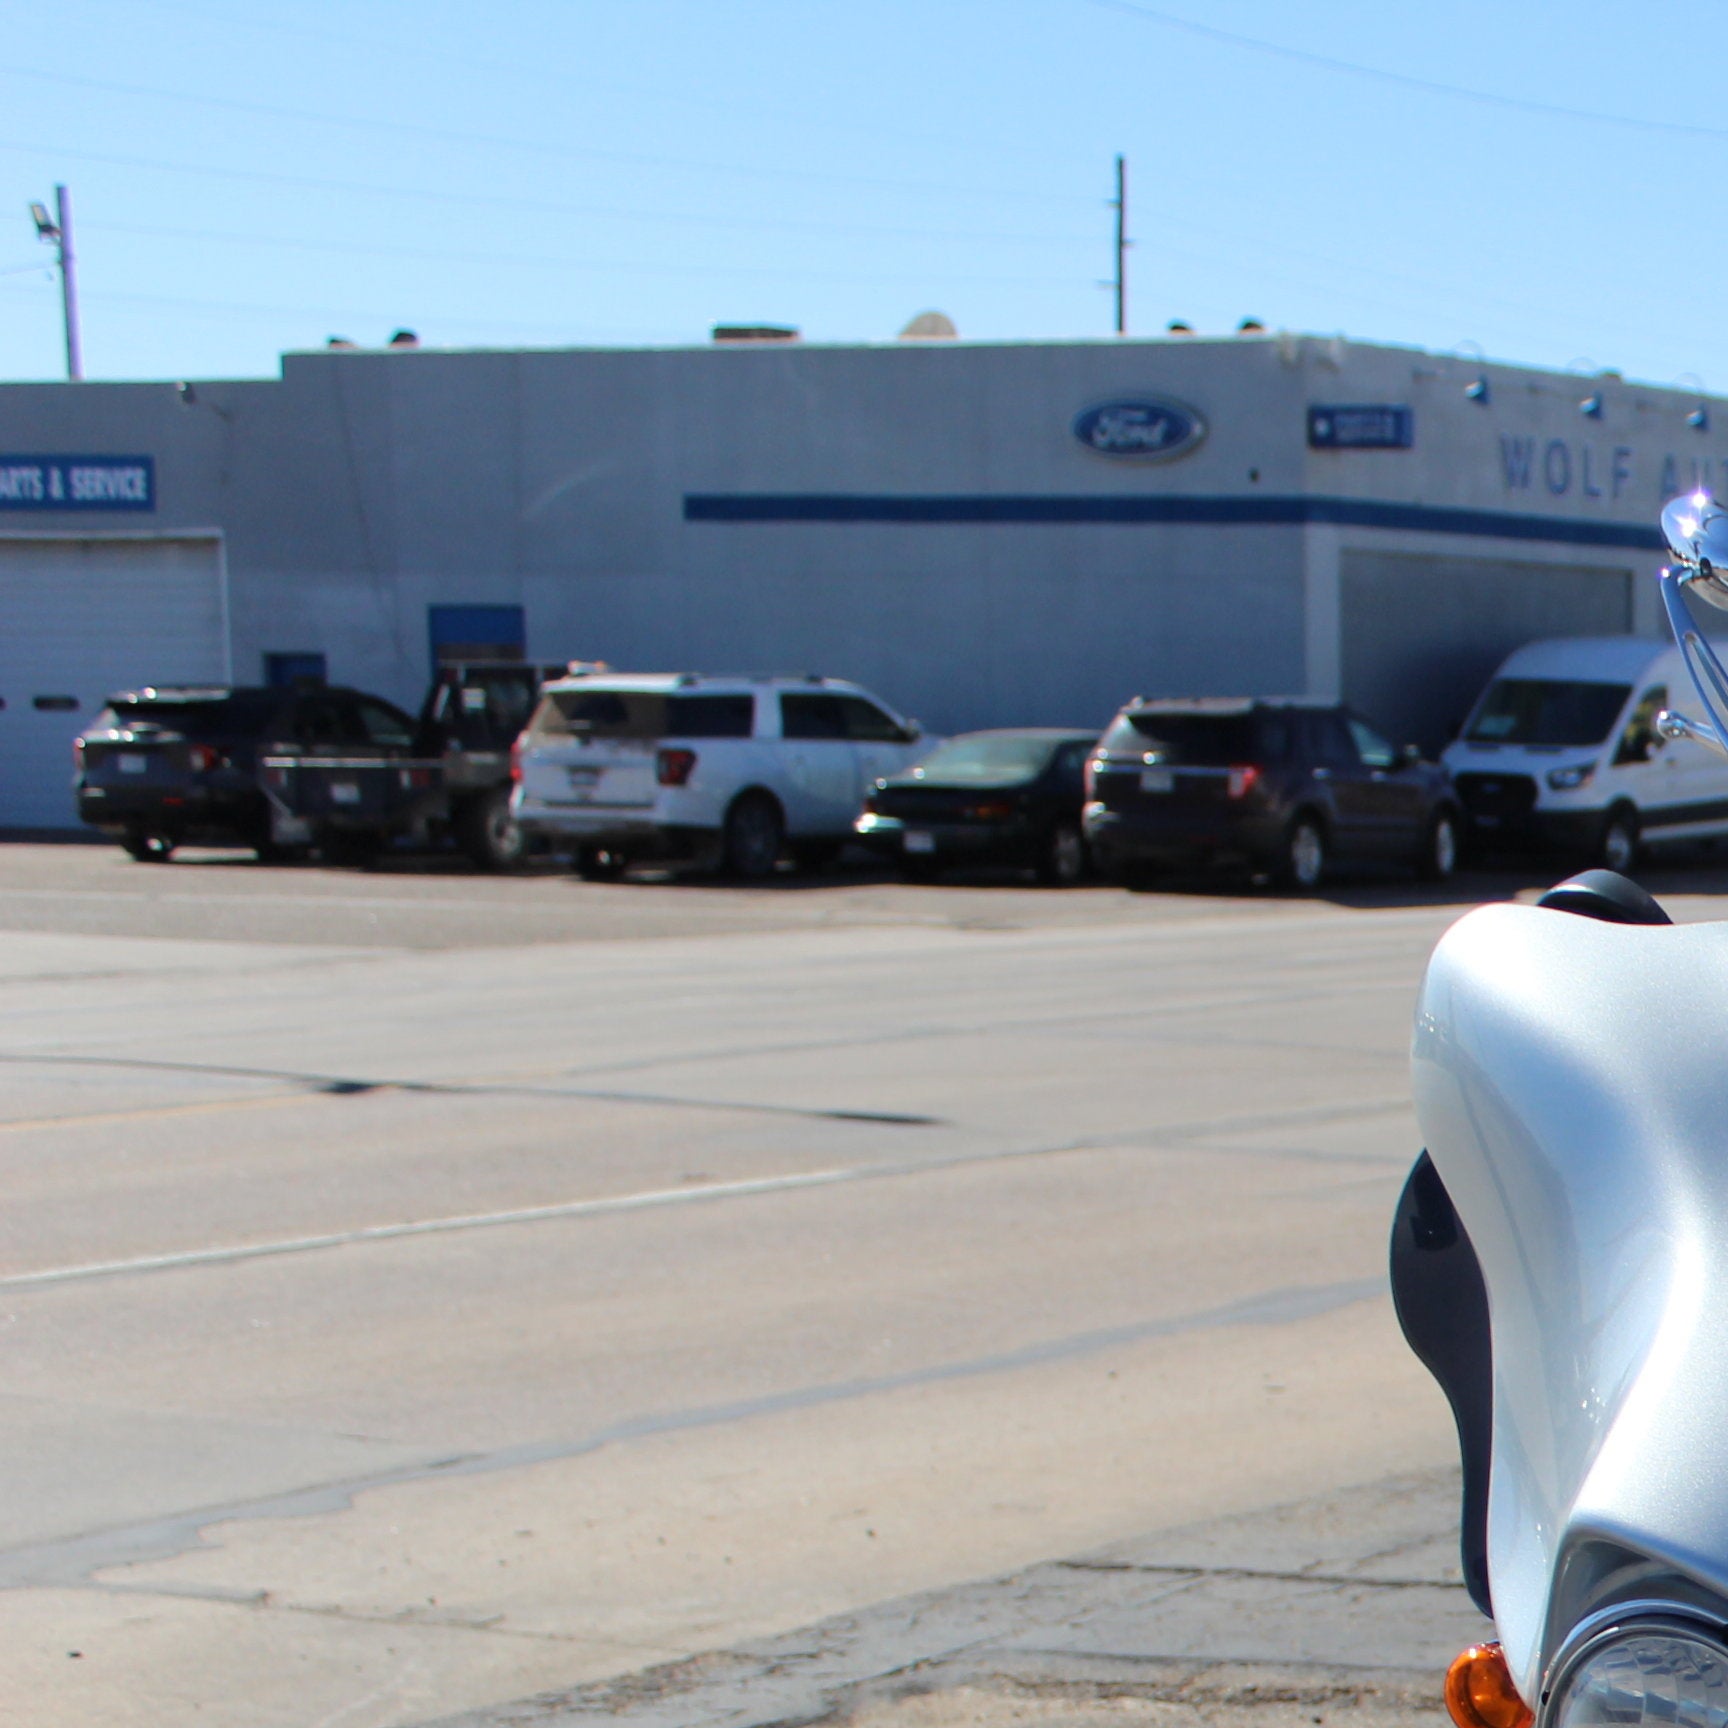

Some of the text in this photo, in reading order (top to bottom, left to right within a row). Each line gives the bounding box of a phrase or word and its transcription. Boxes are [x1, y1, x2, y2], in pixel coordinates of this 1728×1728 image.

[1091, 407, 1168, 449] Ford
[48, 466, 65, 501] &
[69, 466, 148, 501] SERVICE
[1500, 434, 1632, 500] WOLF
